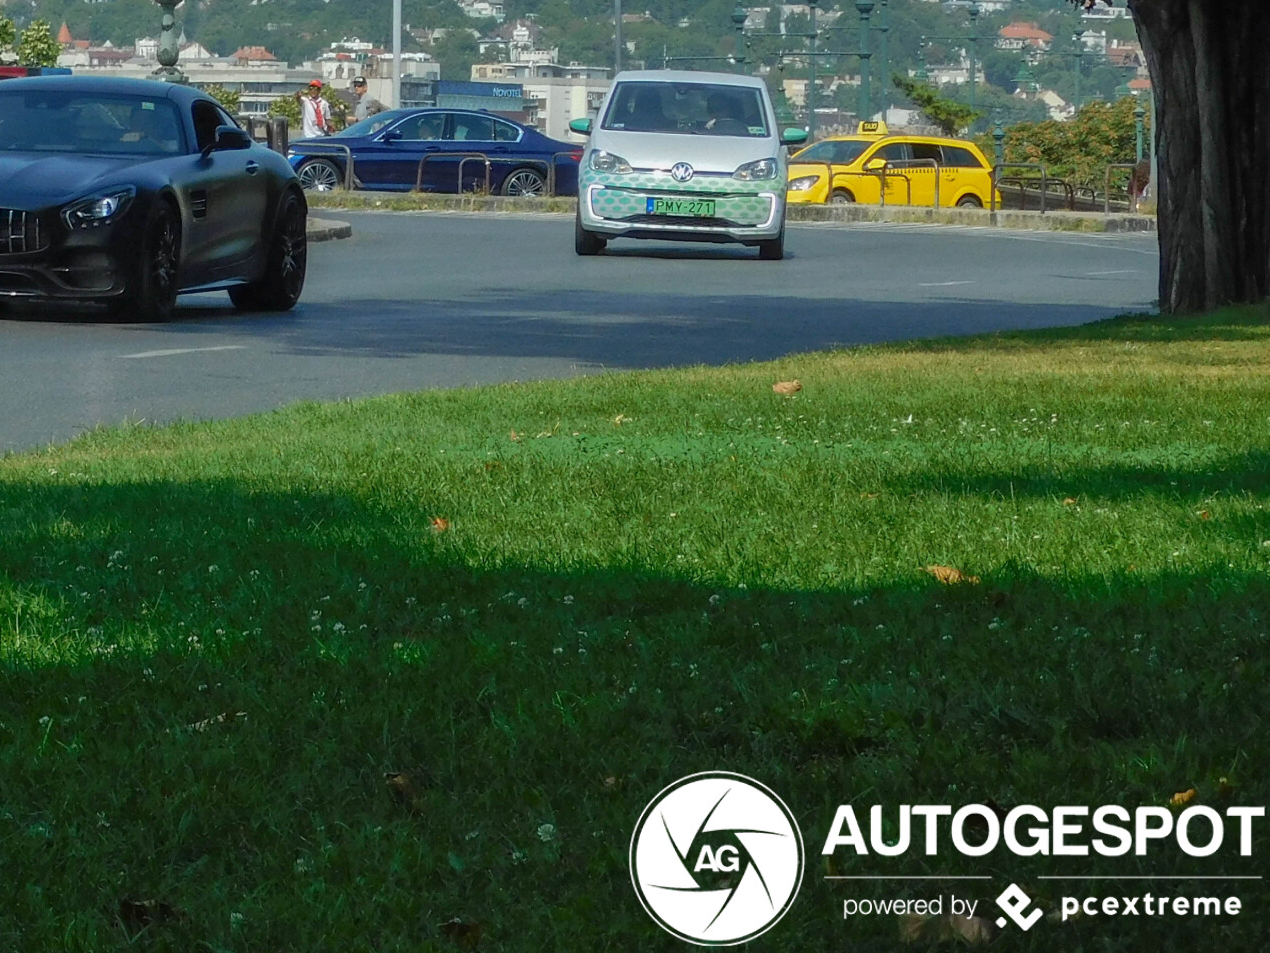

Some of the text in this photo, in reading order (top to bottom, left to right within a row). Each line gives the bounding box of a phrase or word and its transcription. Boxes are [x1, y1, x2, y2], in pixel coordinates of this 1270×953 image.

[492, 87, 522, 98] NOVOTEL
[864, 122, 878, 130] TAXI
[656, 200, 711, 214] PMY-271
